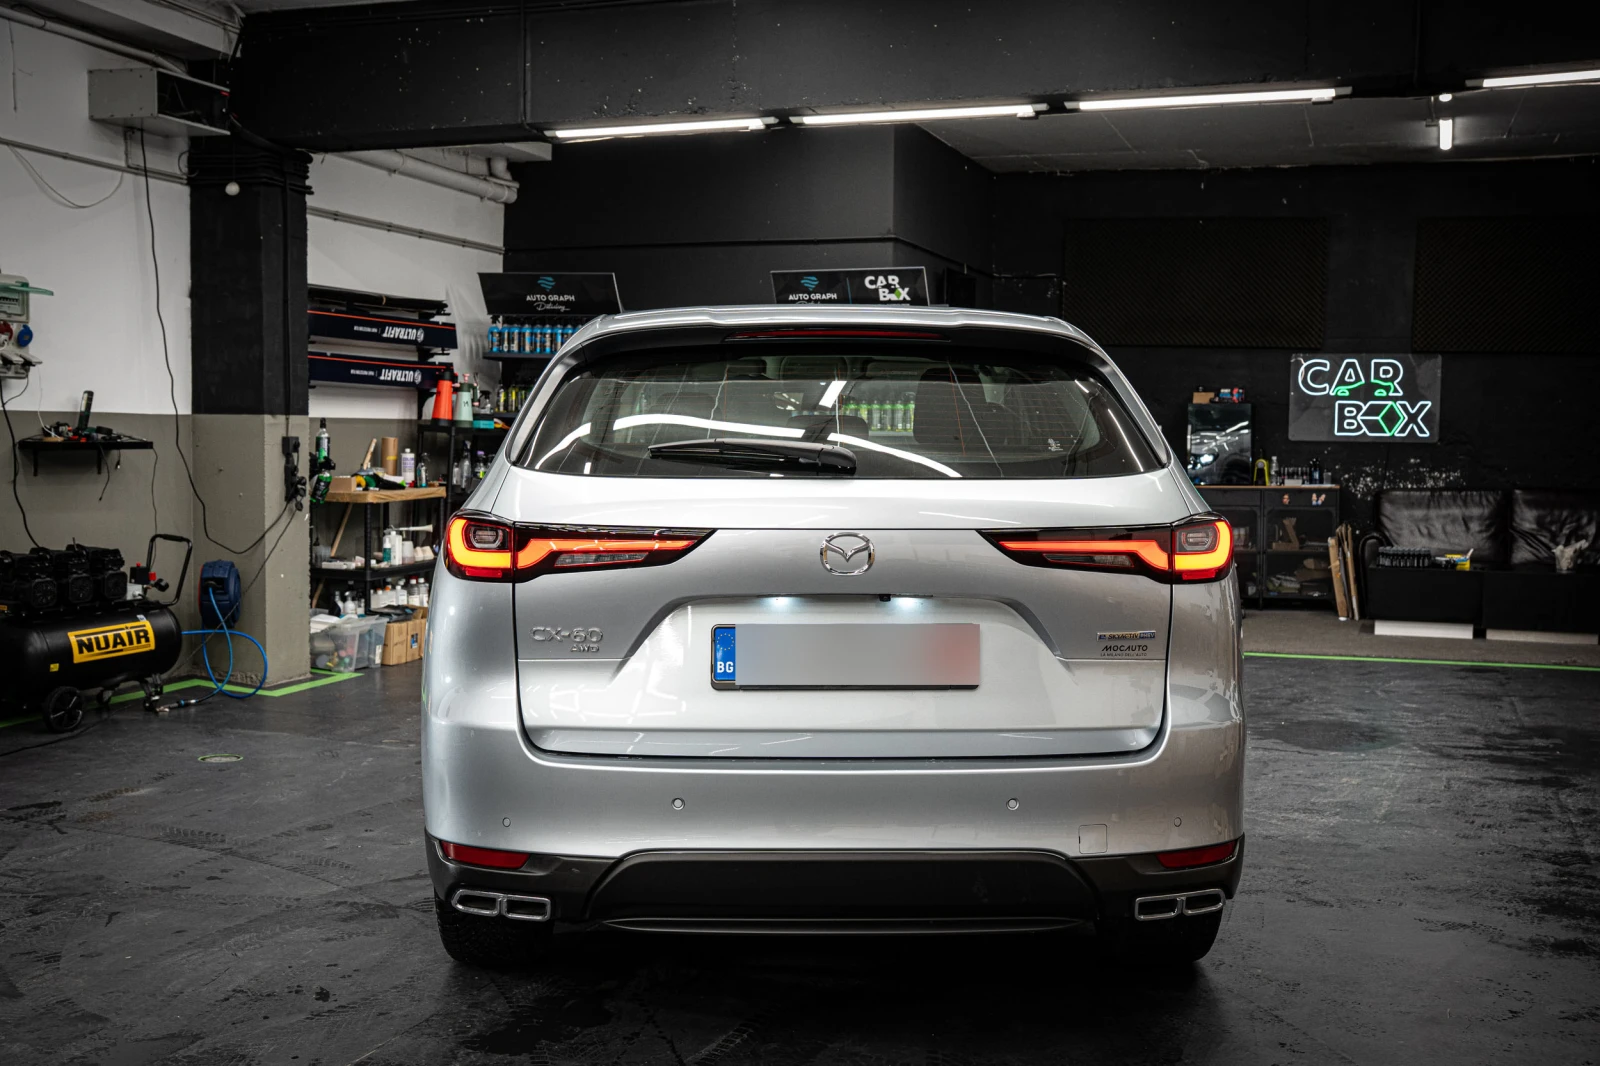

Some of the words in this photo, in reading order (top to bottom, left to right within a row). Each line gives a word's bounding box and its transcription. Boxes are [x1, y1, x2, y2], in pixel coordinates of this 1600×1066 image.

[864, 275, 900, 289] CAR
[526, 294, 547, 302] AUTO
[547, 294, 575, 302] GRAPH
[788, 293, 809, 301] AUTO
[810, 292, 838, 300] GRAPH
[381, 326, 417, 340] ULTRAFIT
[379, 368, 414, 382] ULTRAFIT
[1298, 358, 1404, 396] CAR
[76, 627, 150, 655] NUAIR
[529, 626, 603, 643] CX-60
[570, 643, 600, 653] AWD
[1101, 644, 1148, 652] MOCAUTO
[716, 661, 734, 673] BG
